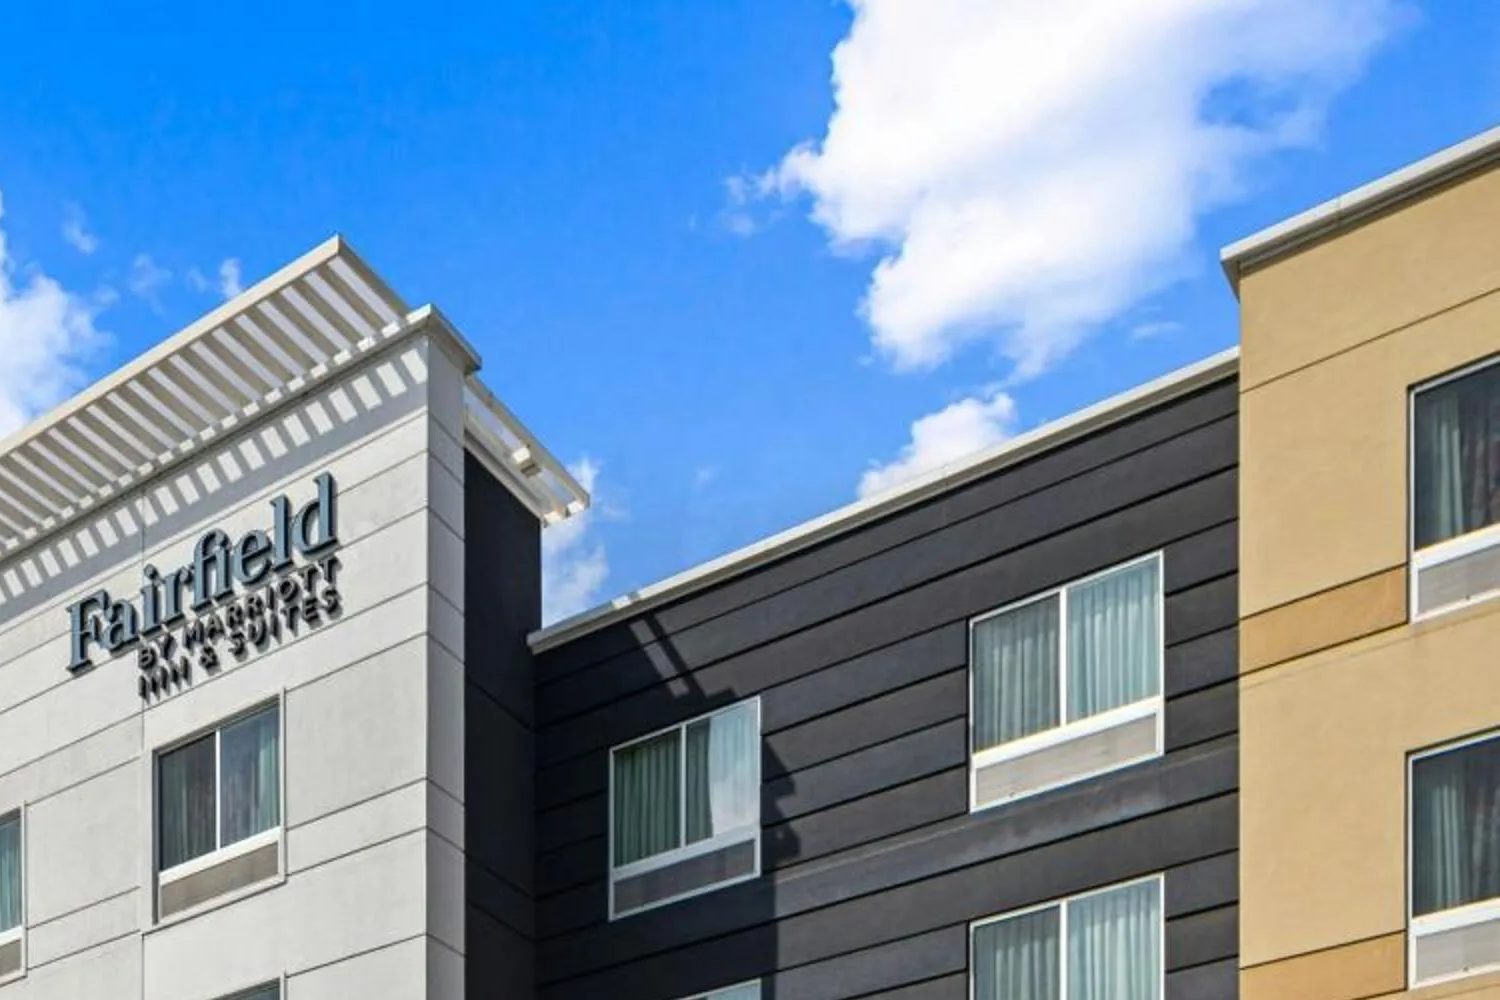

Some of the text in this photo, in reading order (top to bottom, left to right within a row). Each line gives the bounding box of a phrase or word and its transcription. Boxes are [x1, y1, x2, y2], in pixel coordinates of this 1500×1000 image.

[66, 471, 340, 672] Fairfield
[138, 556, 341, 671] BY MARRIOTT
[138, 656, 191, 702] INN
[229, 587, 342, 660] SUITES
